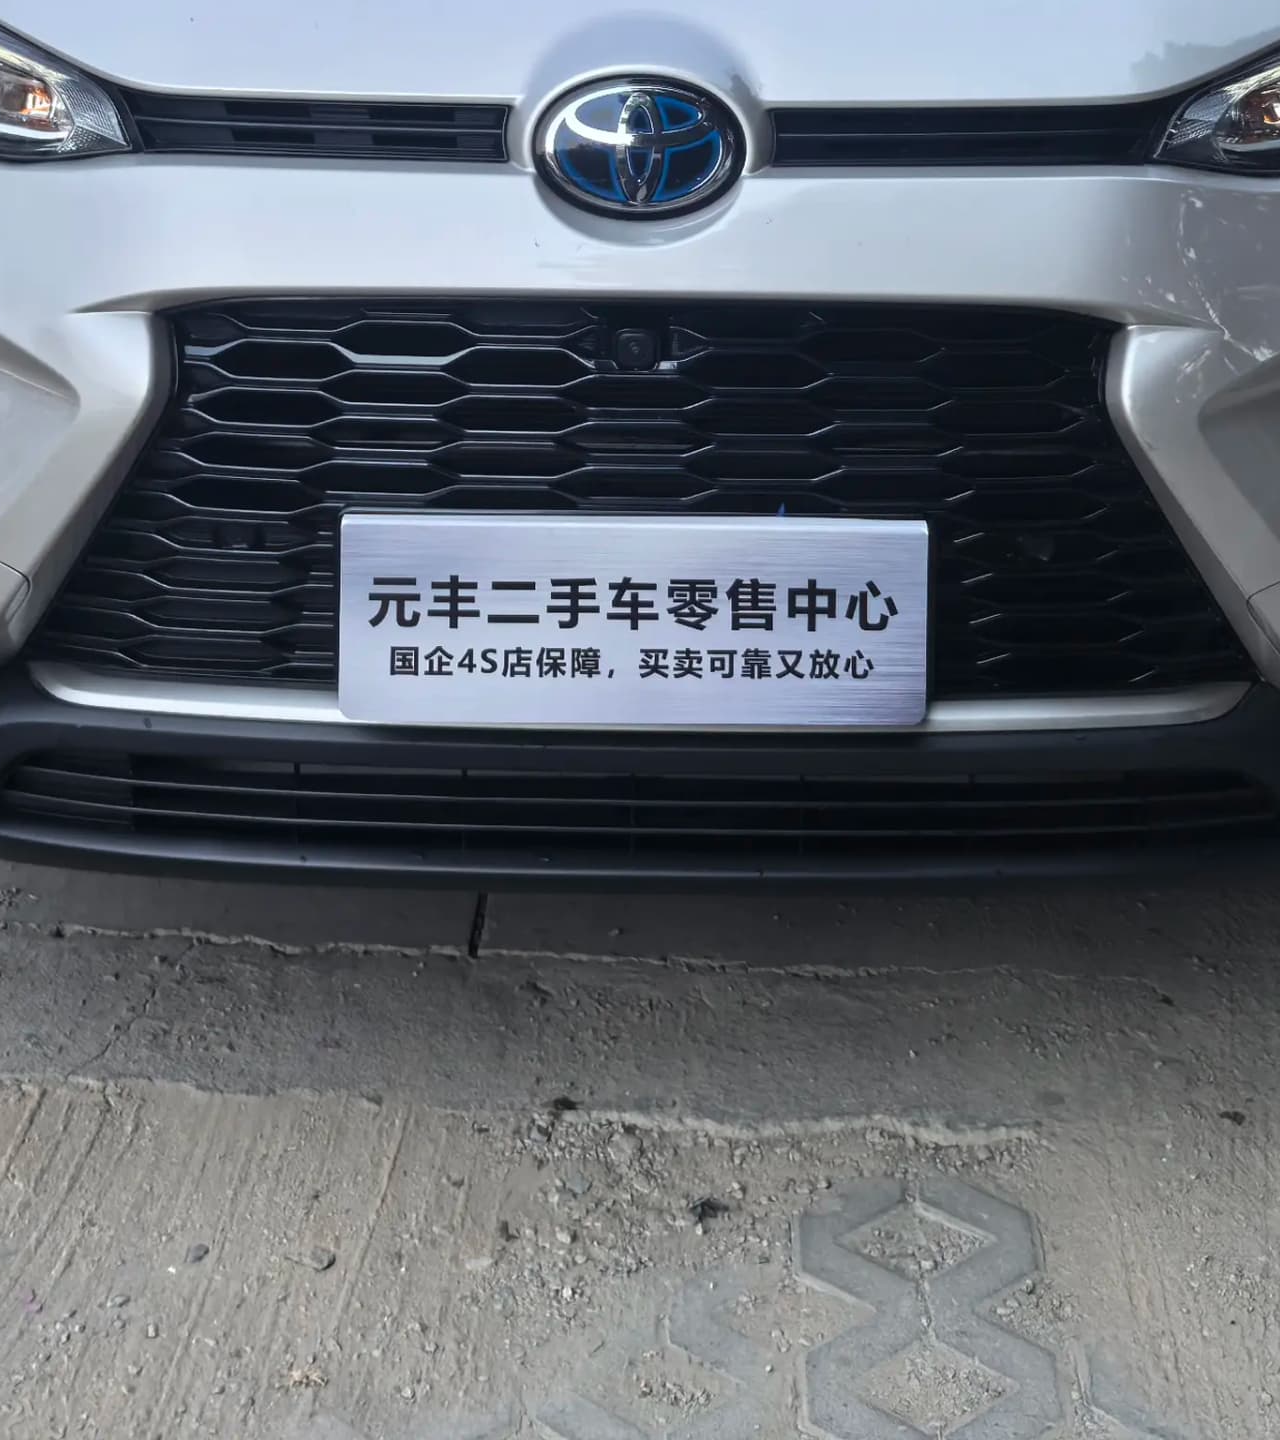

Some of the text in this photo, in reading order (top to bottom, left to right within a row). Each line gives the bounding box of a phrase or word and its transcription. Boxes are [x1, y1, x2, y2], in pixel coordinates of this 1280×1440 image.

[368, 574, 899, 632] 元丰二手车零售中心
